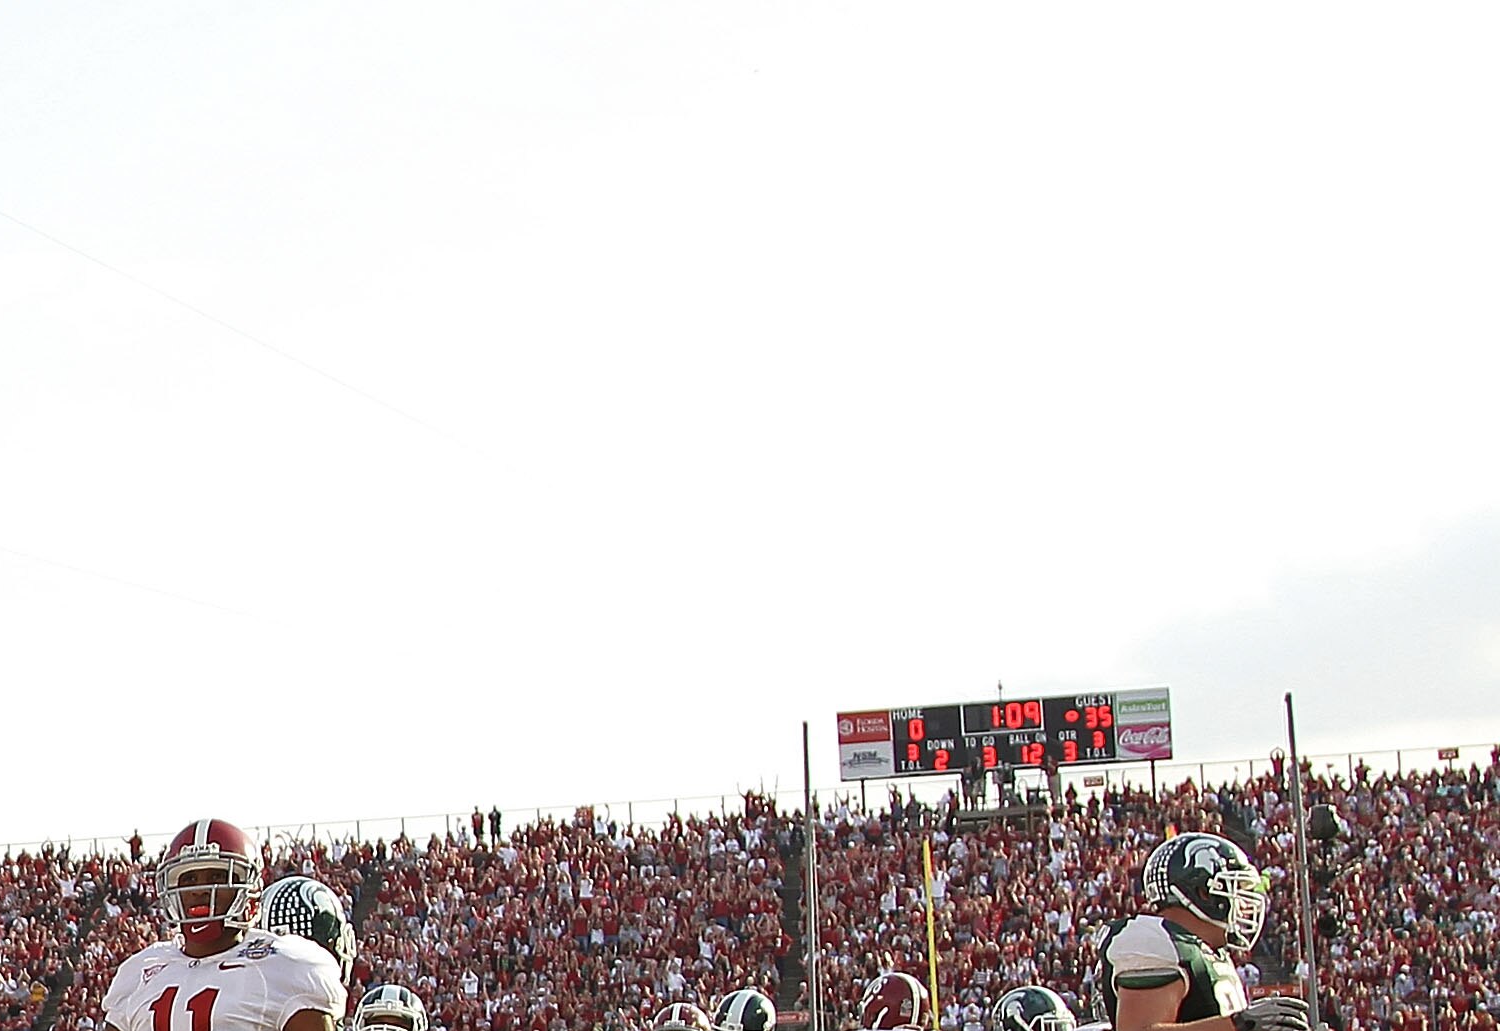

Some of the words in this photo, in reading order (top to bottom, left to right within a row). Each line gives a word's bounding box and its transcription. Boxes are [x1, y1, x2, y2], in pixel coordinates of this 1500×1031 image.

[1075, 694, 1112, 708] GUEST
[893, 709, 924, 720] HOME
[991, 701, 1041, 729] 1:09
[1085, 705, 1114, 729] 35
[908, 719, 925, 741] 0
[1009, 733, 1030, 744] BALL
[1035, 732, 1047, 743] ON
[1058, 730, 1077, 741] QTR
[927, 738, 955, 750] DOWN
[965, 738, 976, 748] TO
[982, 736, 995, 746] GO
[1092, 731, 1106, 748] 3
[907, 743, 920, 761] 3
[982, 746, 998, 768] 3
[1021, 742, 1045, 765] 12
[1063, 740, 1078, 762] 3
[934, 750, 949, 771] 2
